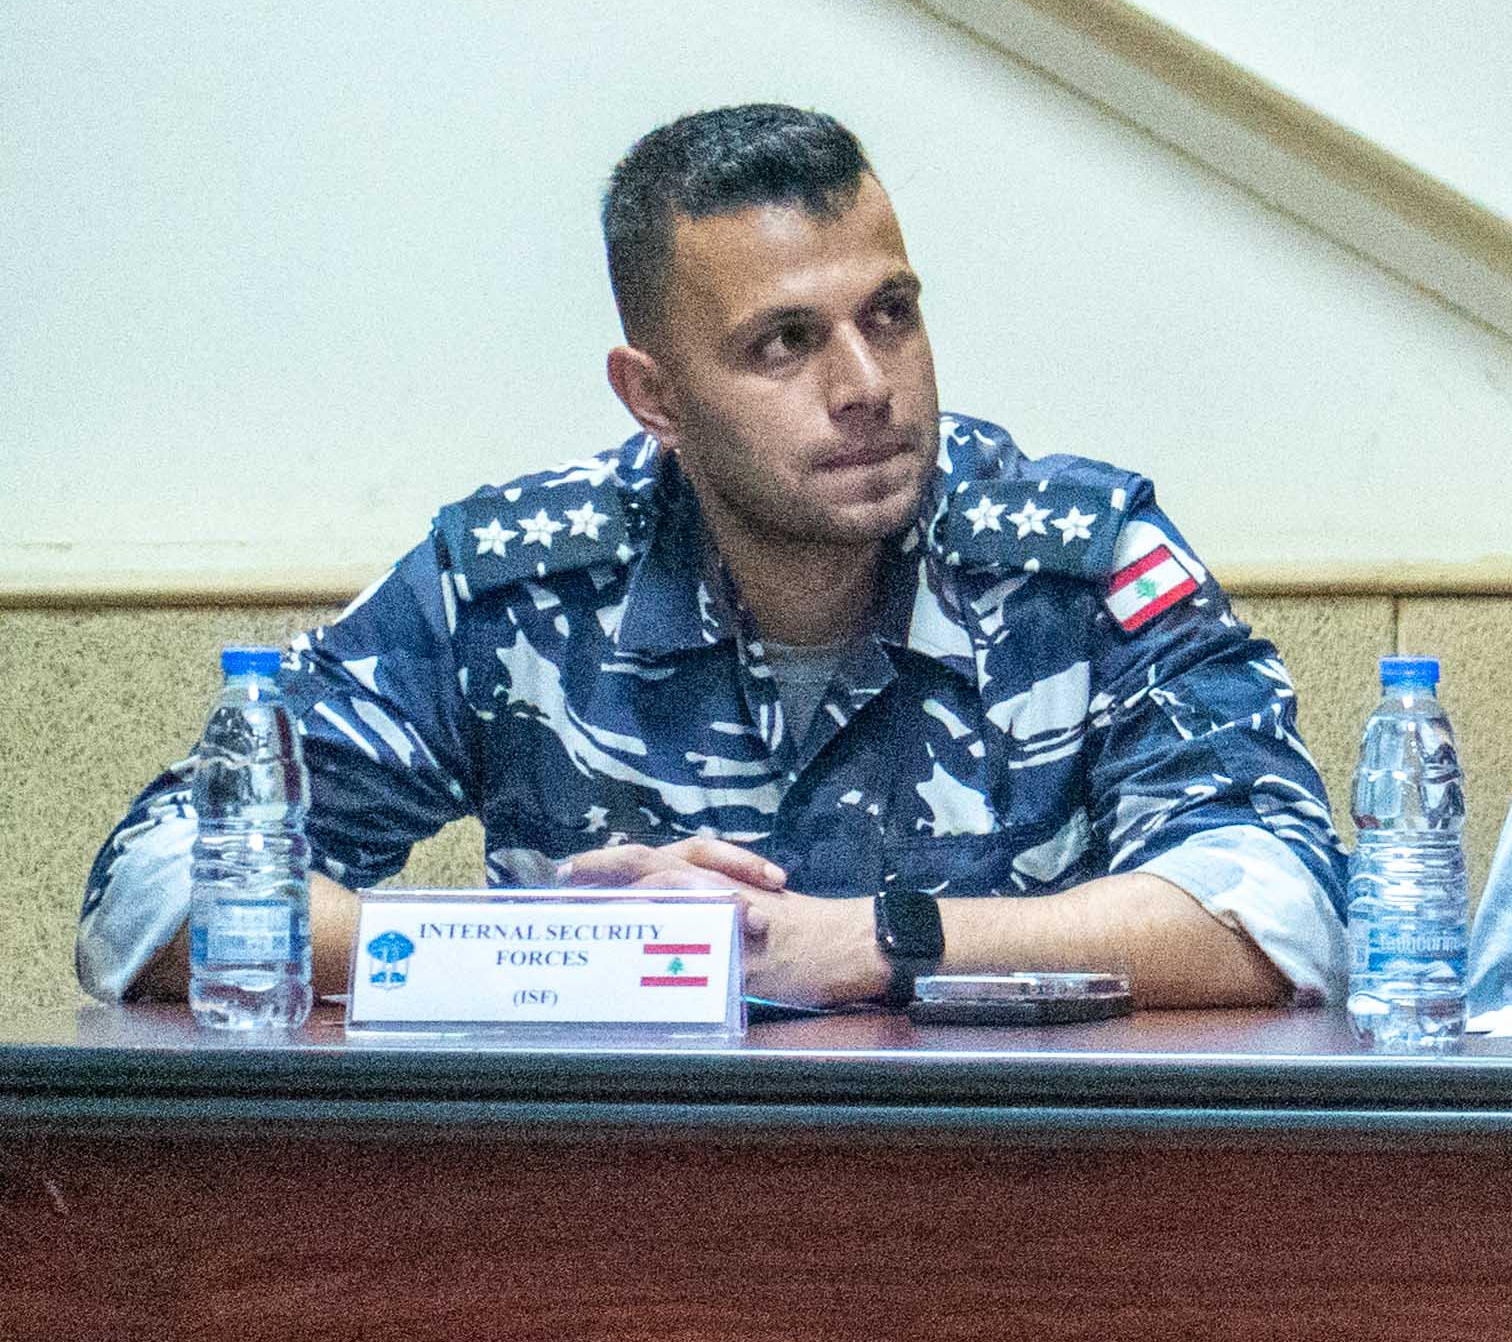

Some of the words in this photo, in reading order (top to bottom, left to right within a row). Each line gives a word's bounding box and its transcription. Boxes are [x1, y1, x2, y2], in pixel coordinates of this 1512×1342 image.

[418, 923, 542, 941] INTERNAL
[545, 924, 665, 941] SECURITY
[496, 949, 589, 967] FORCES
[512, 989, 558, 1007] (ISF)
